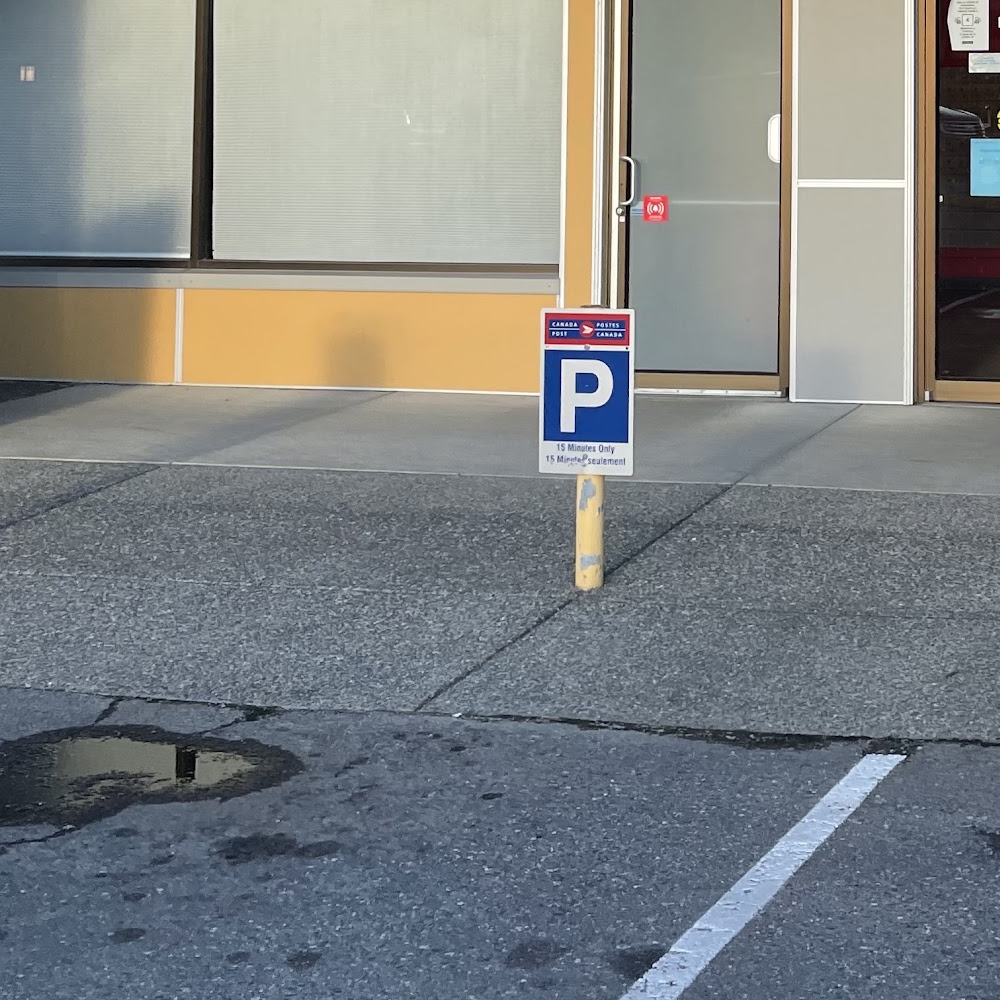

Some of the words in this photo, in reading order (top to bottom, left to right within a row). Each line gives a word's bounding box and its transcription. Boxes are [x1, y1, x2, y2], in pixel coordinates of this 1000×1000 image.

[560, 358, 614, 433] P
[556, 442, 566, 452] 15
[567, 443, 596, 453] Minutes
[598, 444, 616, 455] Only
[545, 454, 555, 464] 15
[587, 456, 626, 466] seulement
